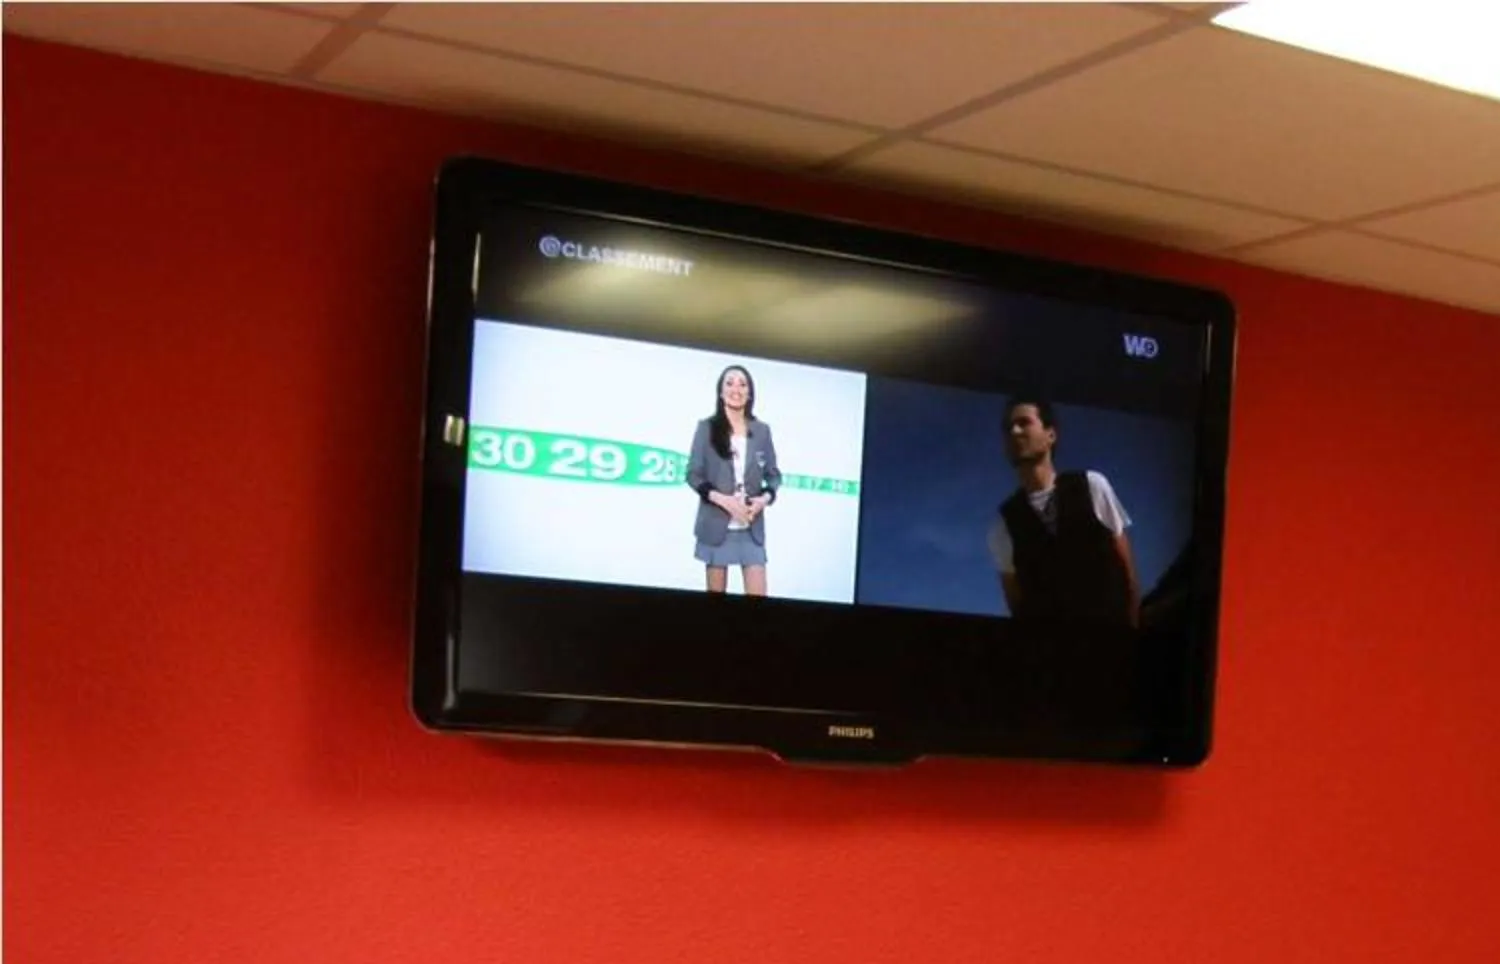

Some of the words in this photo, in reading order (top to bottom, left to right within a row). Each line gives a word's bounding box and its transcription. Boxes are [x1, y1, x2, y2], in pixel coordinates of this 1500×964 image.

[472, 431, 535, 469] 30
[547, 439, 627, 480] 29
[828, 725, 874, 739] PHILIPS
